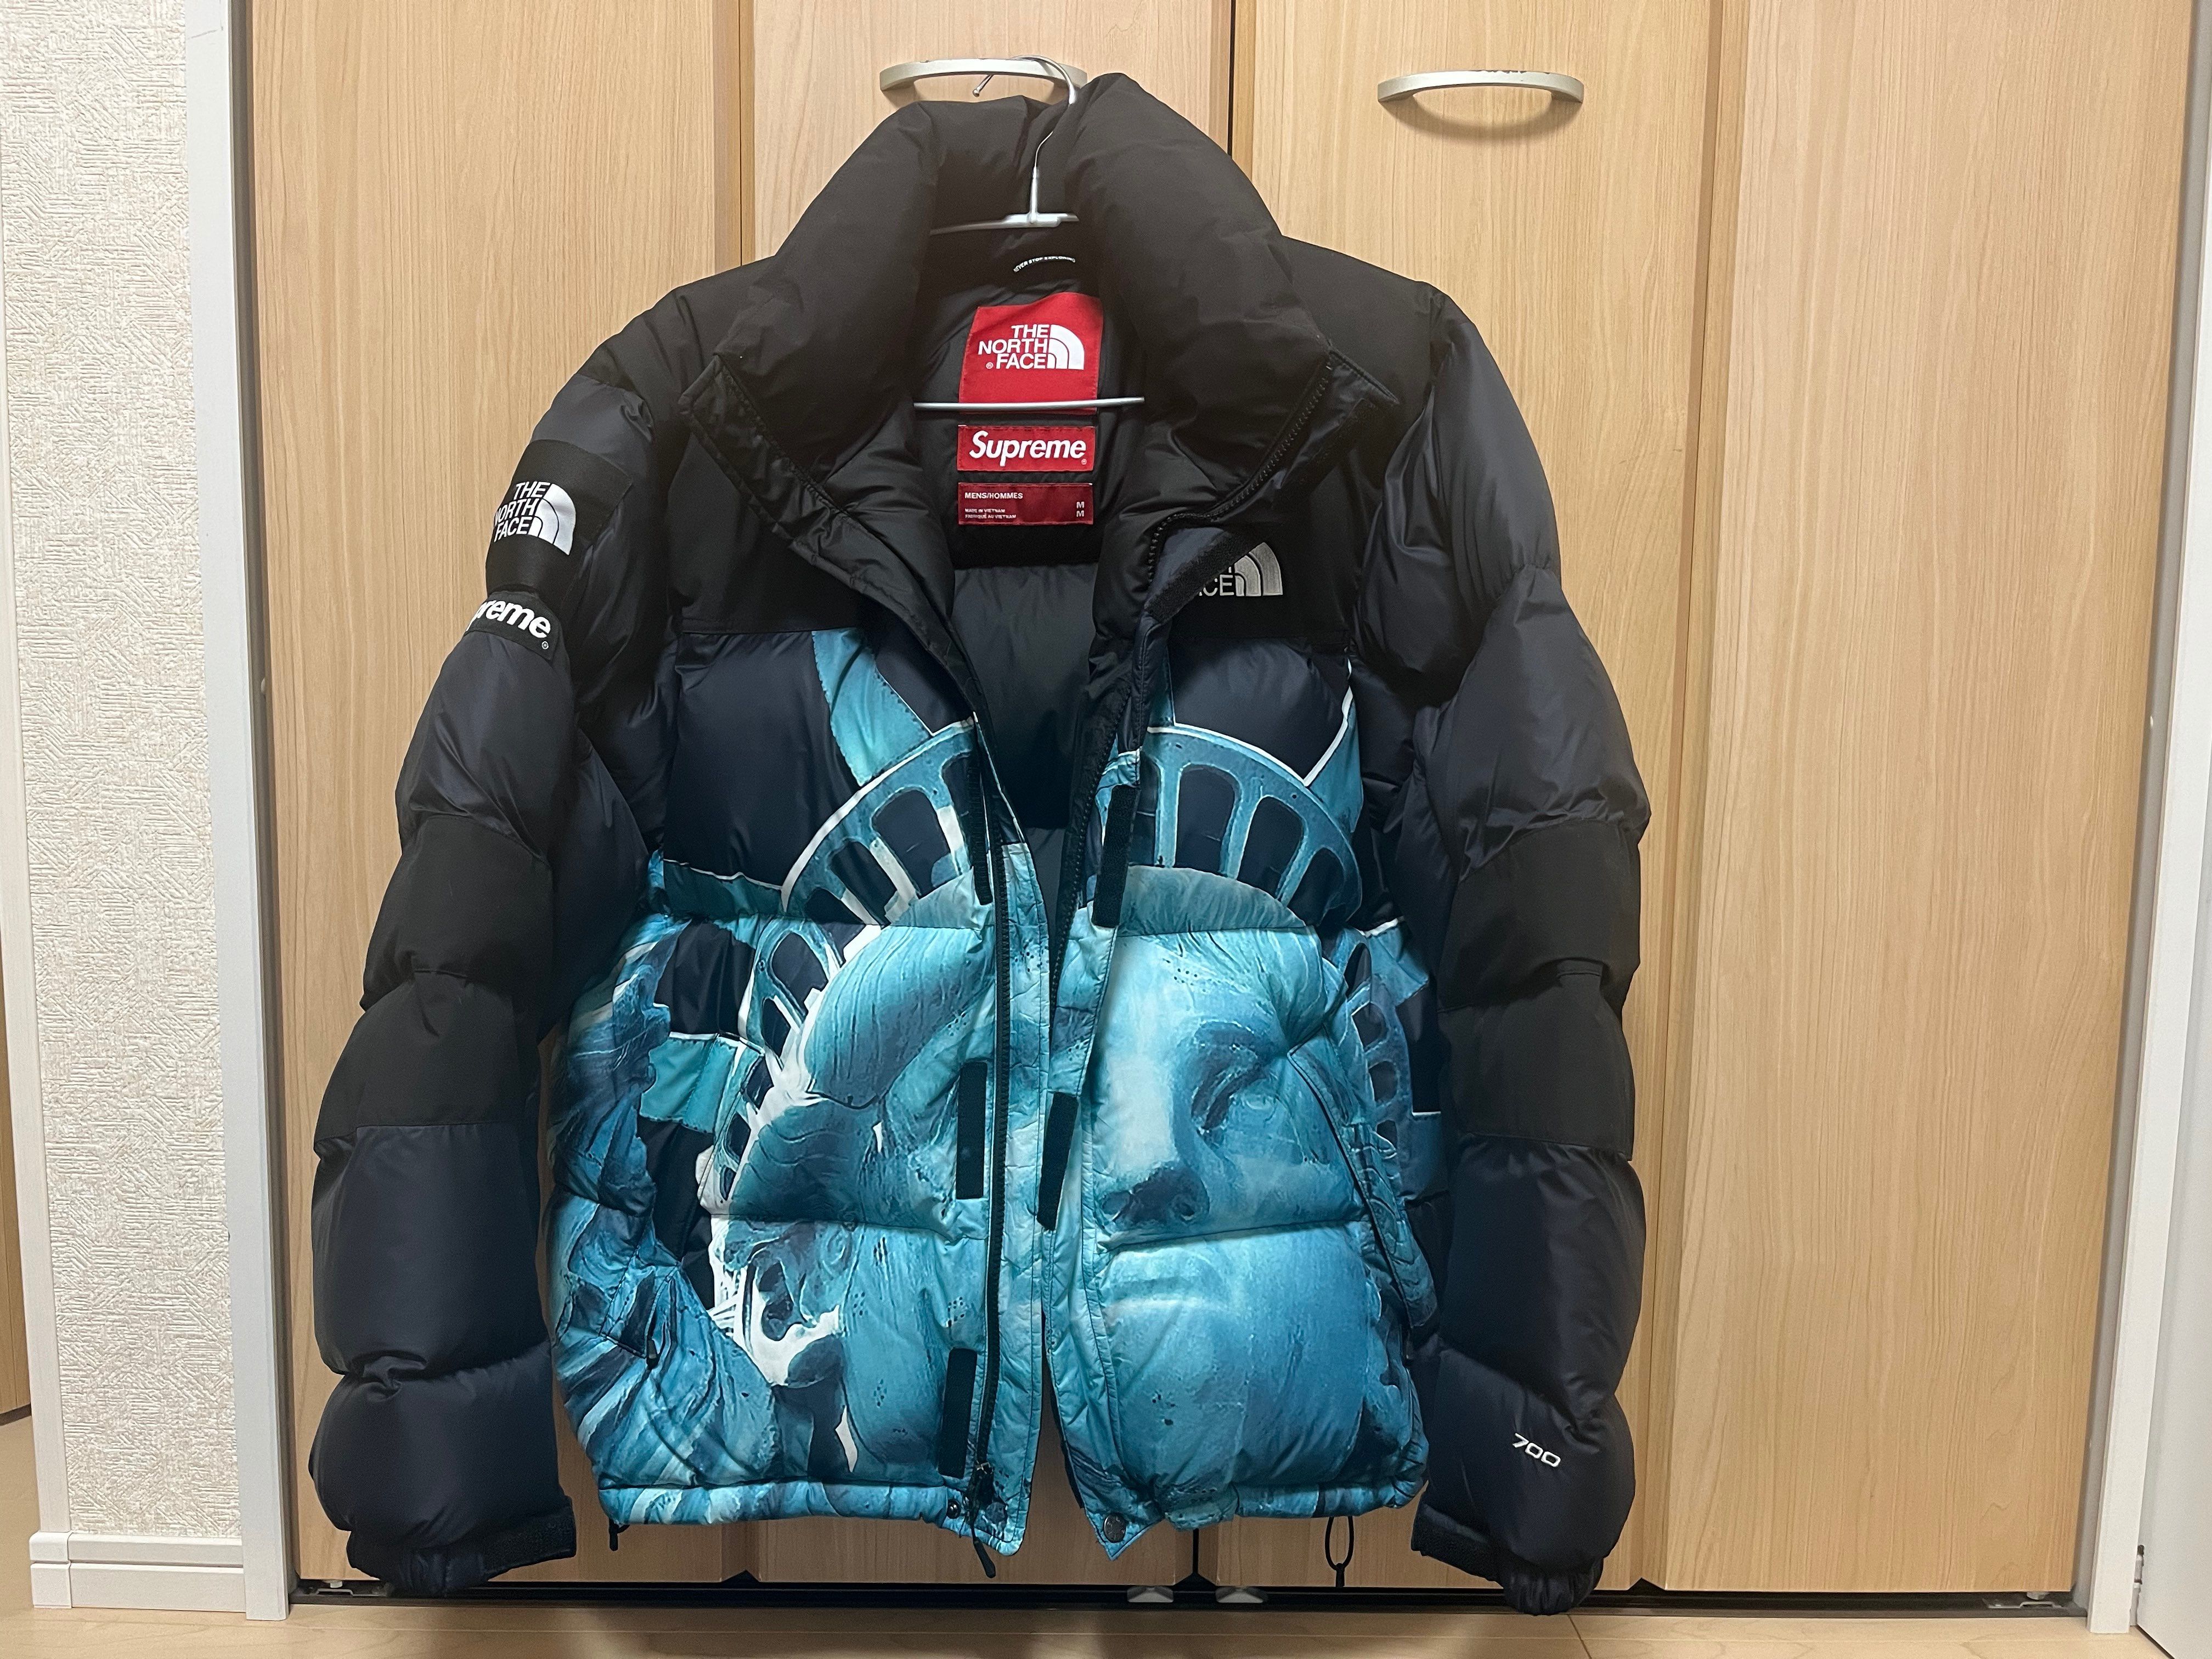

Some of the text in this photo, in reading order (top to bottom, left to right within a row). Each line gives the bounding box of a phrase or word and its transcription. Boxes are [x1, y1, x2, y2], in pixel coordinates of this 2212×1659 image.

[1011, 324, 1049, 338] THE
[978, 338, 1048, 354] NORTH
[996, 353, 1046, 369] FACE
[969, 430, 1086, 466] Supreme
[513, 482, 550, 500] THE
[494, 498, 540, 527] NORTH
[494, 516, 533, 543] FACE
[1513, 1433, 1561, 1467] 700
